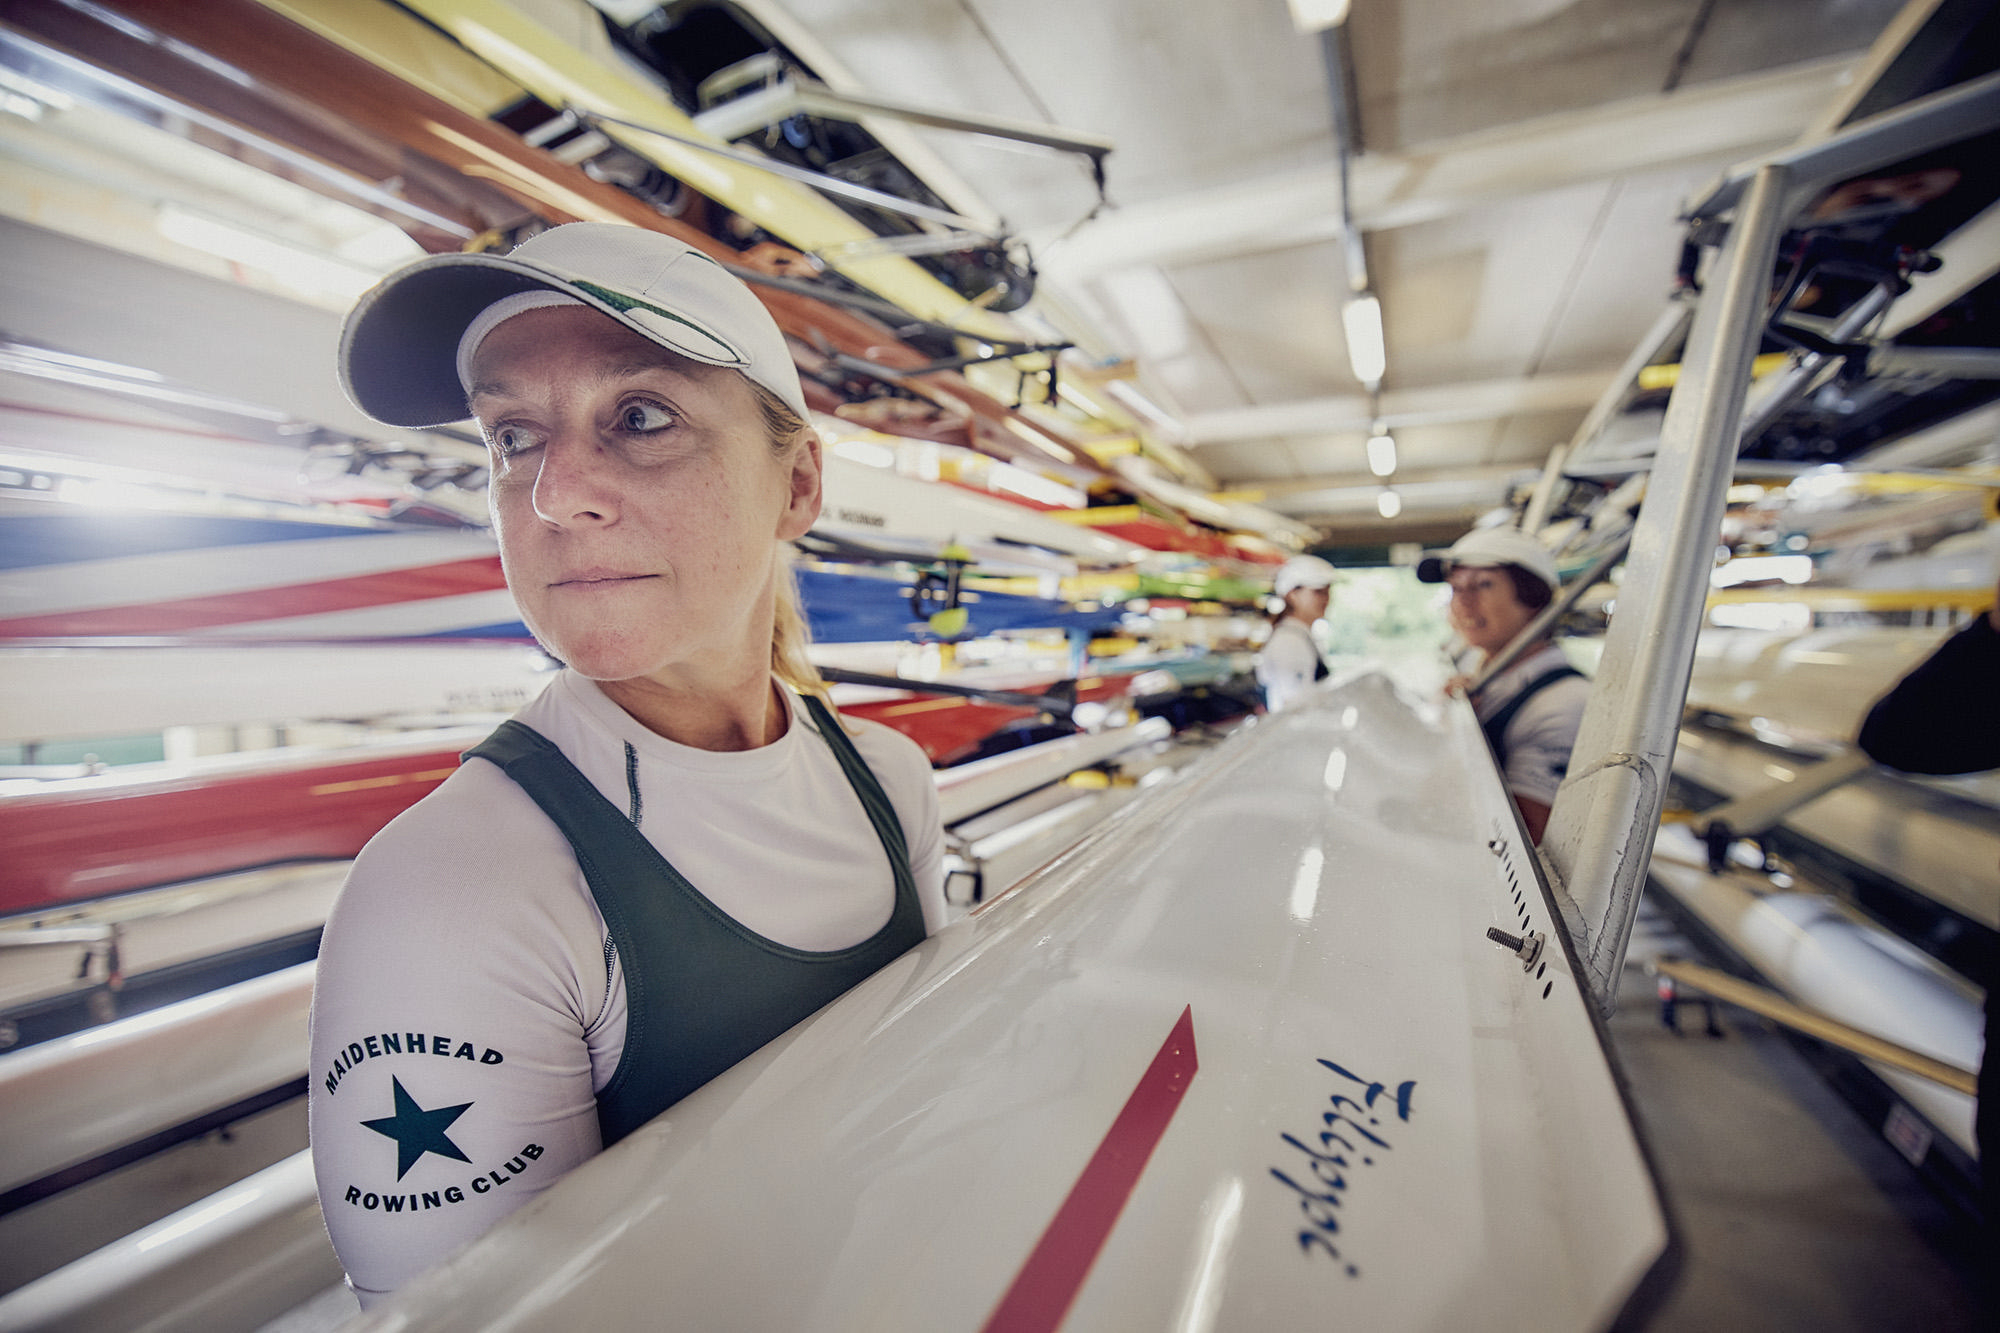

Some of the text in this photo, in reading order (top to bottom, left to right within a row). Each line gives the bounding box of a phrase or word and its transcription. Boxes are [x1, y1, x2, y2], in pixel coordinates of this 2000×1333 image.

[325, 1032, 504, 1095] MAIDENHEAD
[345, 1143, 545, 1212] ROWING CLUB
[1269, 1058, 1418, 1278] Filippi
